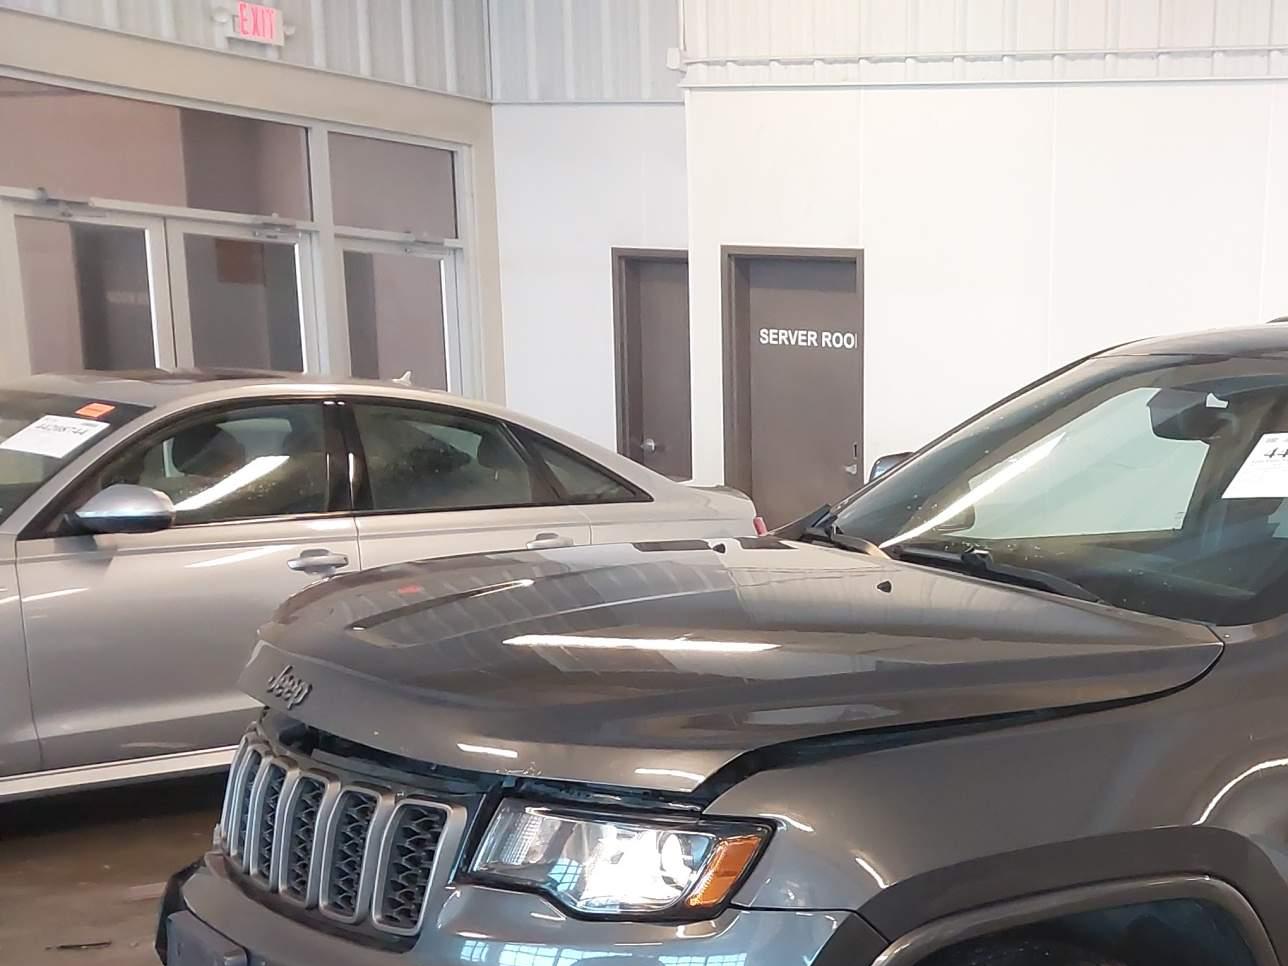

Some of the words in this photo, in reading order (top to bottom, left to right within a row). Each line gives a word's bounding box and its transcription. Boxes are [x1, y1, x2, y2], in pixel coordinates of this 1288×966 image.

[239, 3, 275, 39] EXIT
[759, 328, 818, 347] SERVER
[267, 664, 313, 711] Jeep
